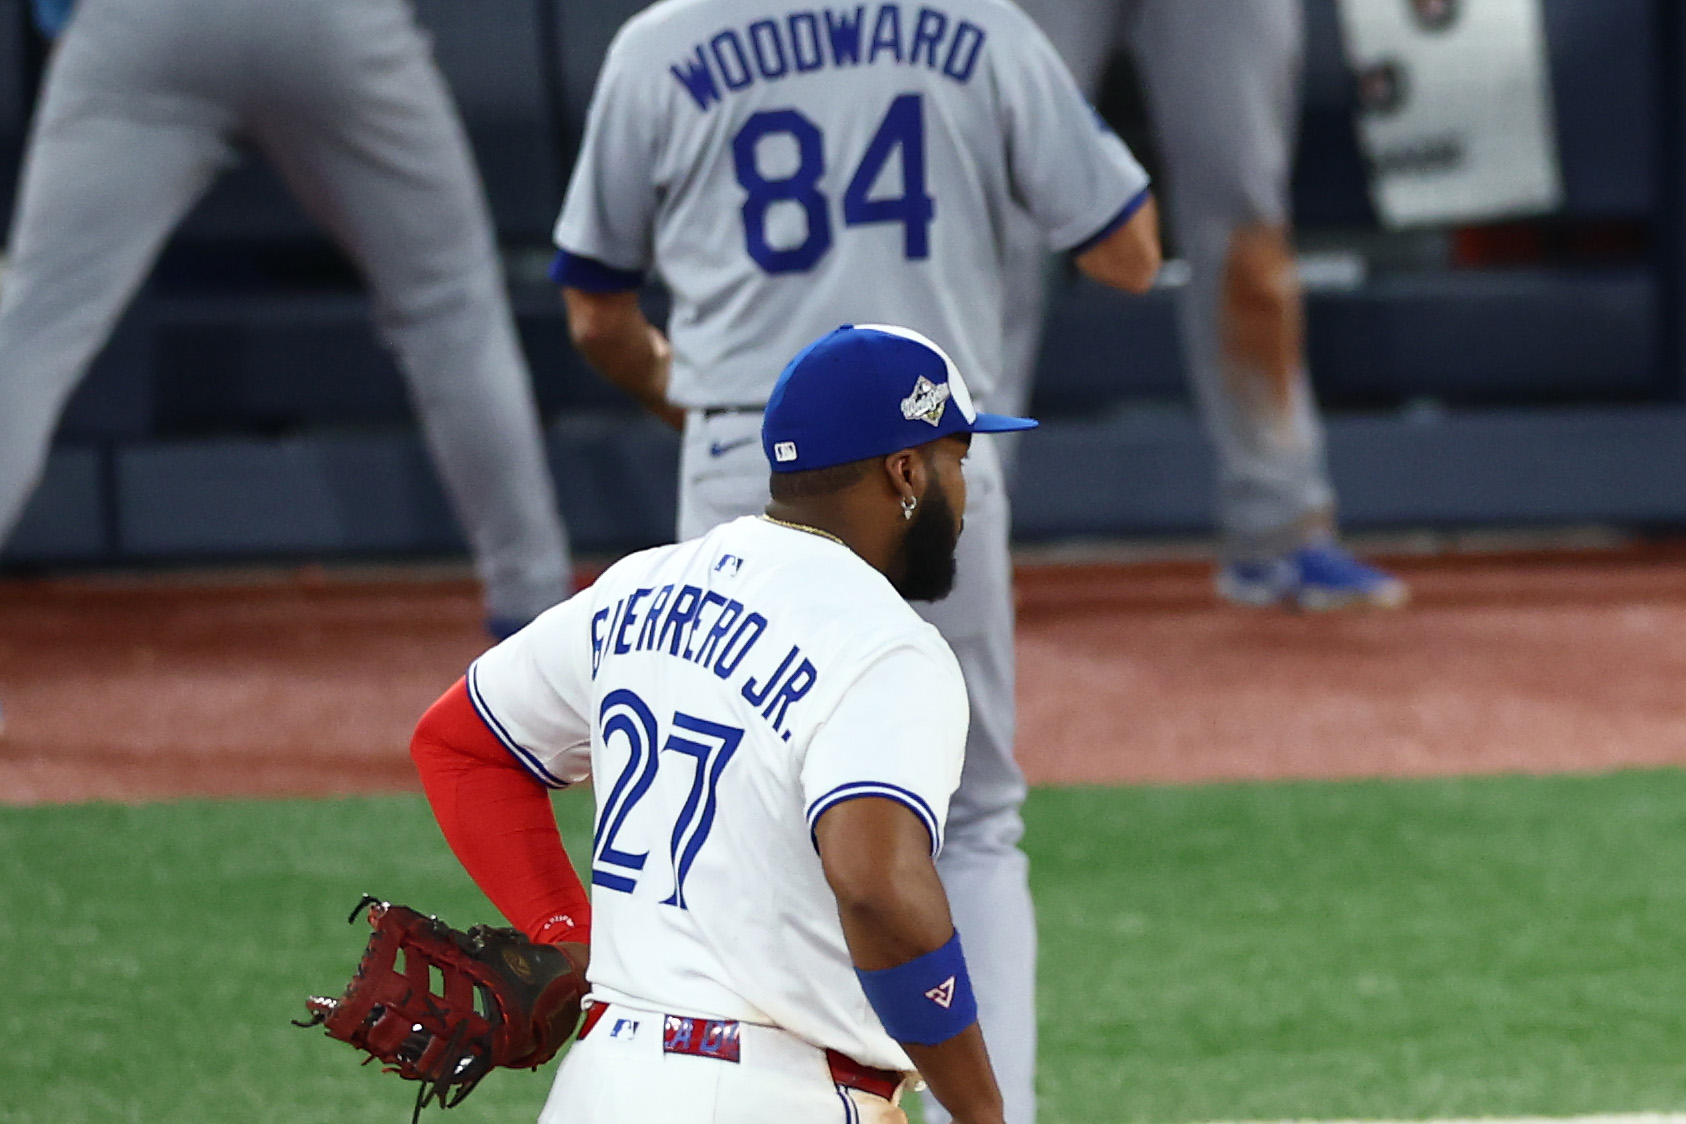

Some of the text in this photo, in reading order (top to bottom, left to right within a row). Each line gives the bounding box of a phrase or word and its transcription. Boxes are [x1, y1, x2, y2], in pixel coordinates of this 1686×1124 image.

[670, 4, 986, 111] WOODWARD
[733, 93, 935, 276] 84
[741, 644, 818, 743] JR.
[591, 688, 746, 911] 27
